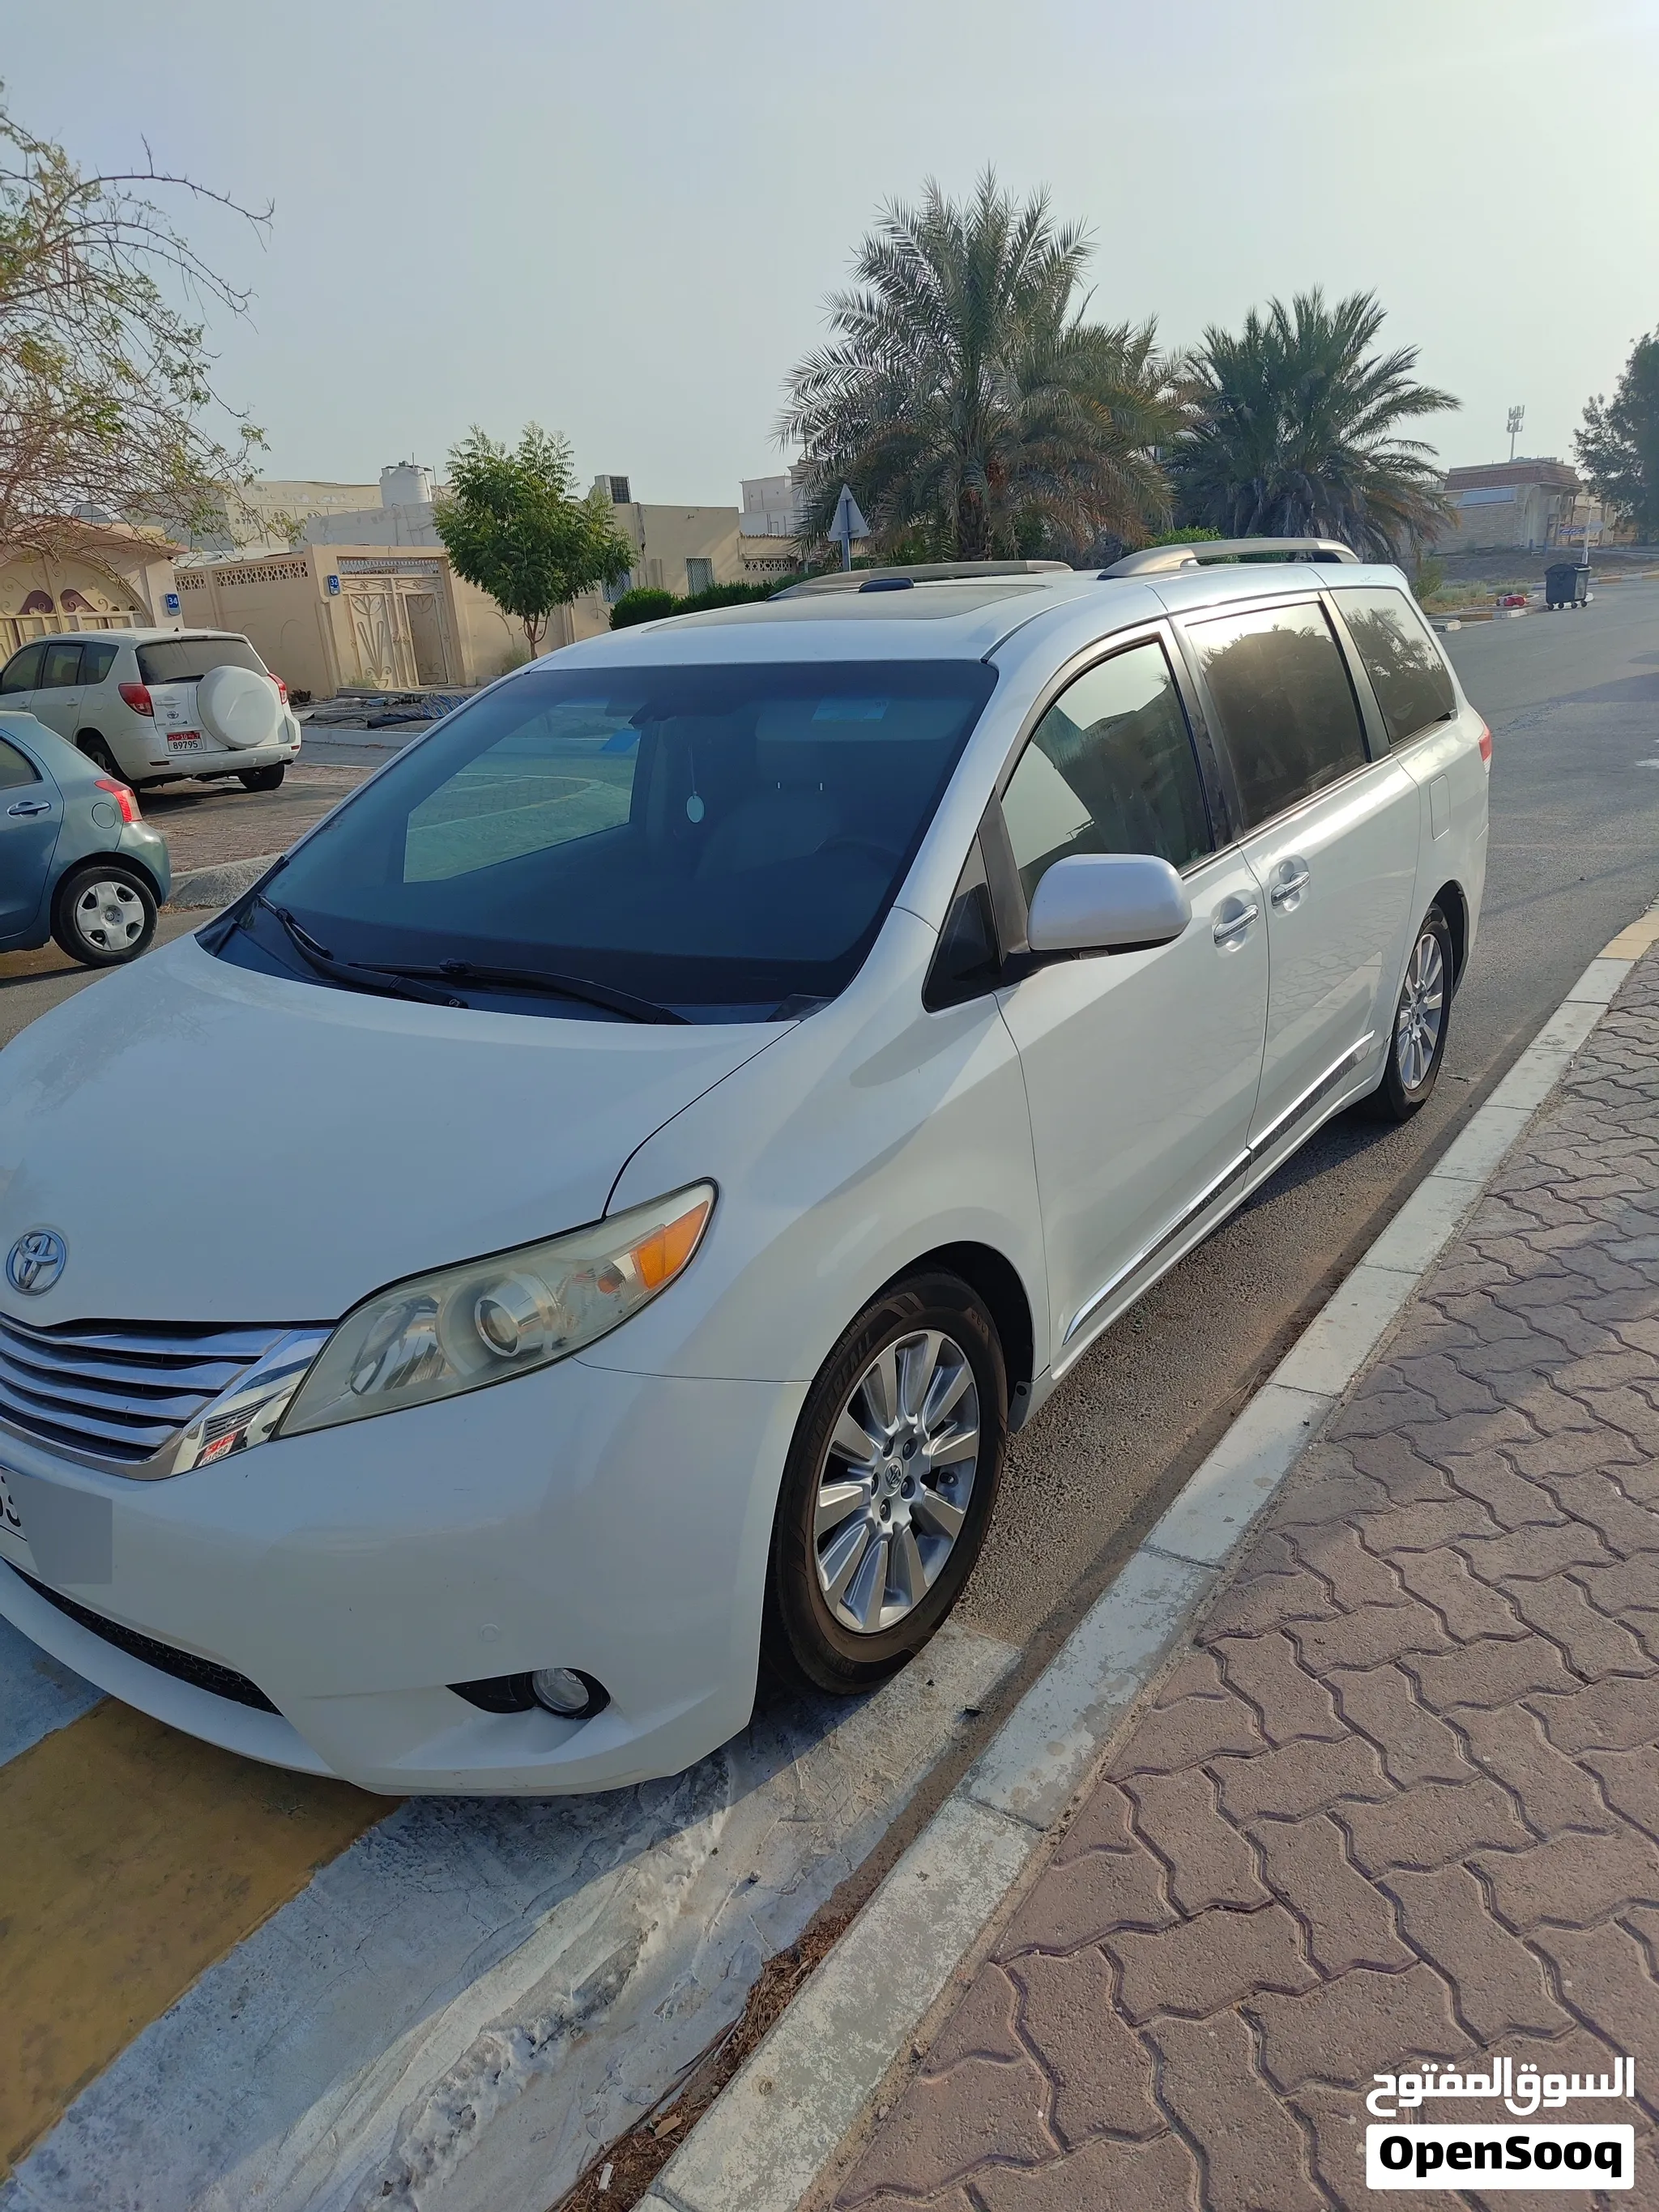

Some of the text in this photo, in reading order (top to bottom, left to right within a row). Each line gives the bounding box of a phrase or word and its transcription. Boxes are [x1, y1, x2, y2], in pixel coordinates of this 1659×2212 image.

[330, 578, 339, 586] 32
[168, 597, 178, 605] 34
[173, 740, 198, 750] 89795
